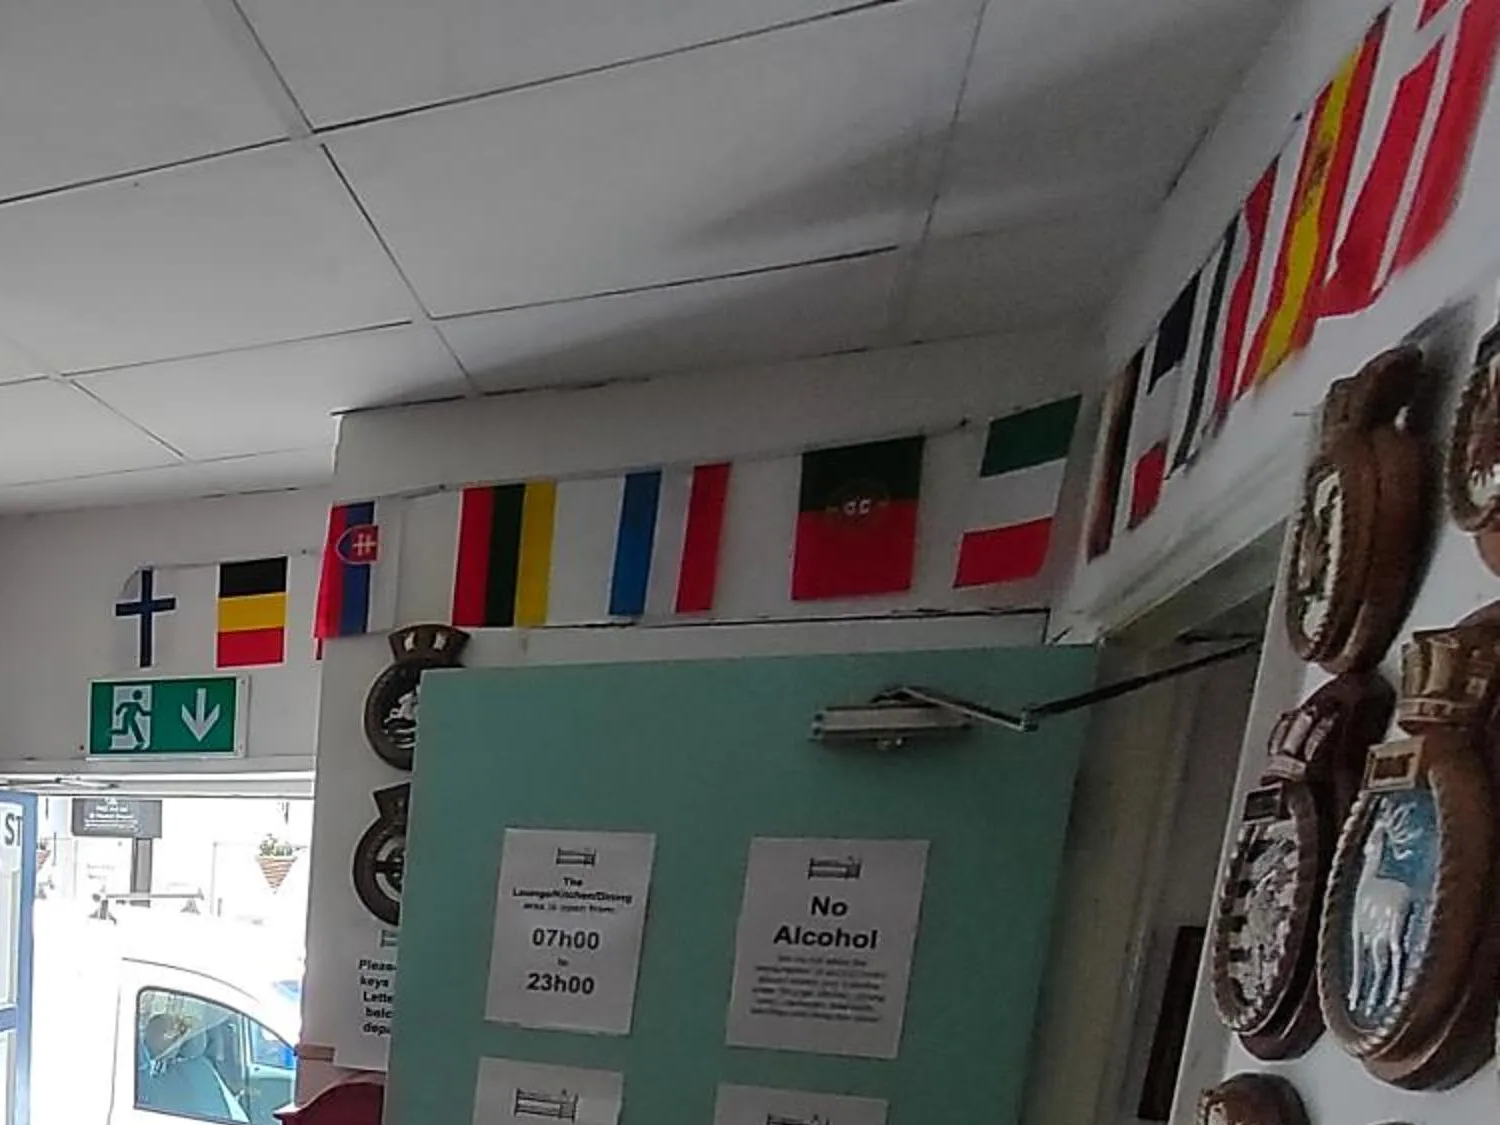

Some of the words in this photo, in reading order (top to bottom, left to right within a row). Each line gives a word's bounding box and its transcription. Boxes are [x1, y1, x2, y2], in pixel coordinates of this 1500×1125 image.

[564, 876, 583, 887] The
[810, 895, 848, 917] No
[532, 927, 600, 951] 07h00
[772, 925, 879, 950] Alcohol
[526, 972, 595, 996] 23h00
